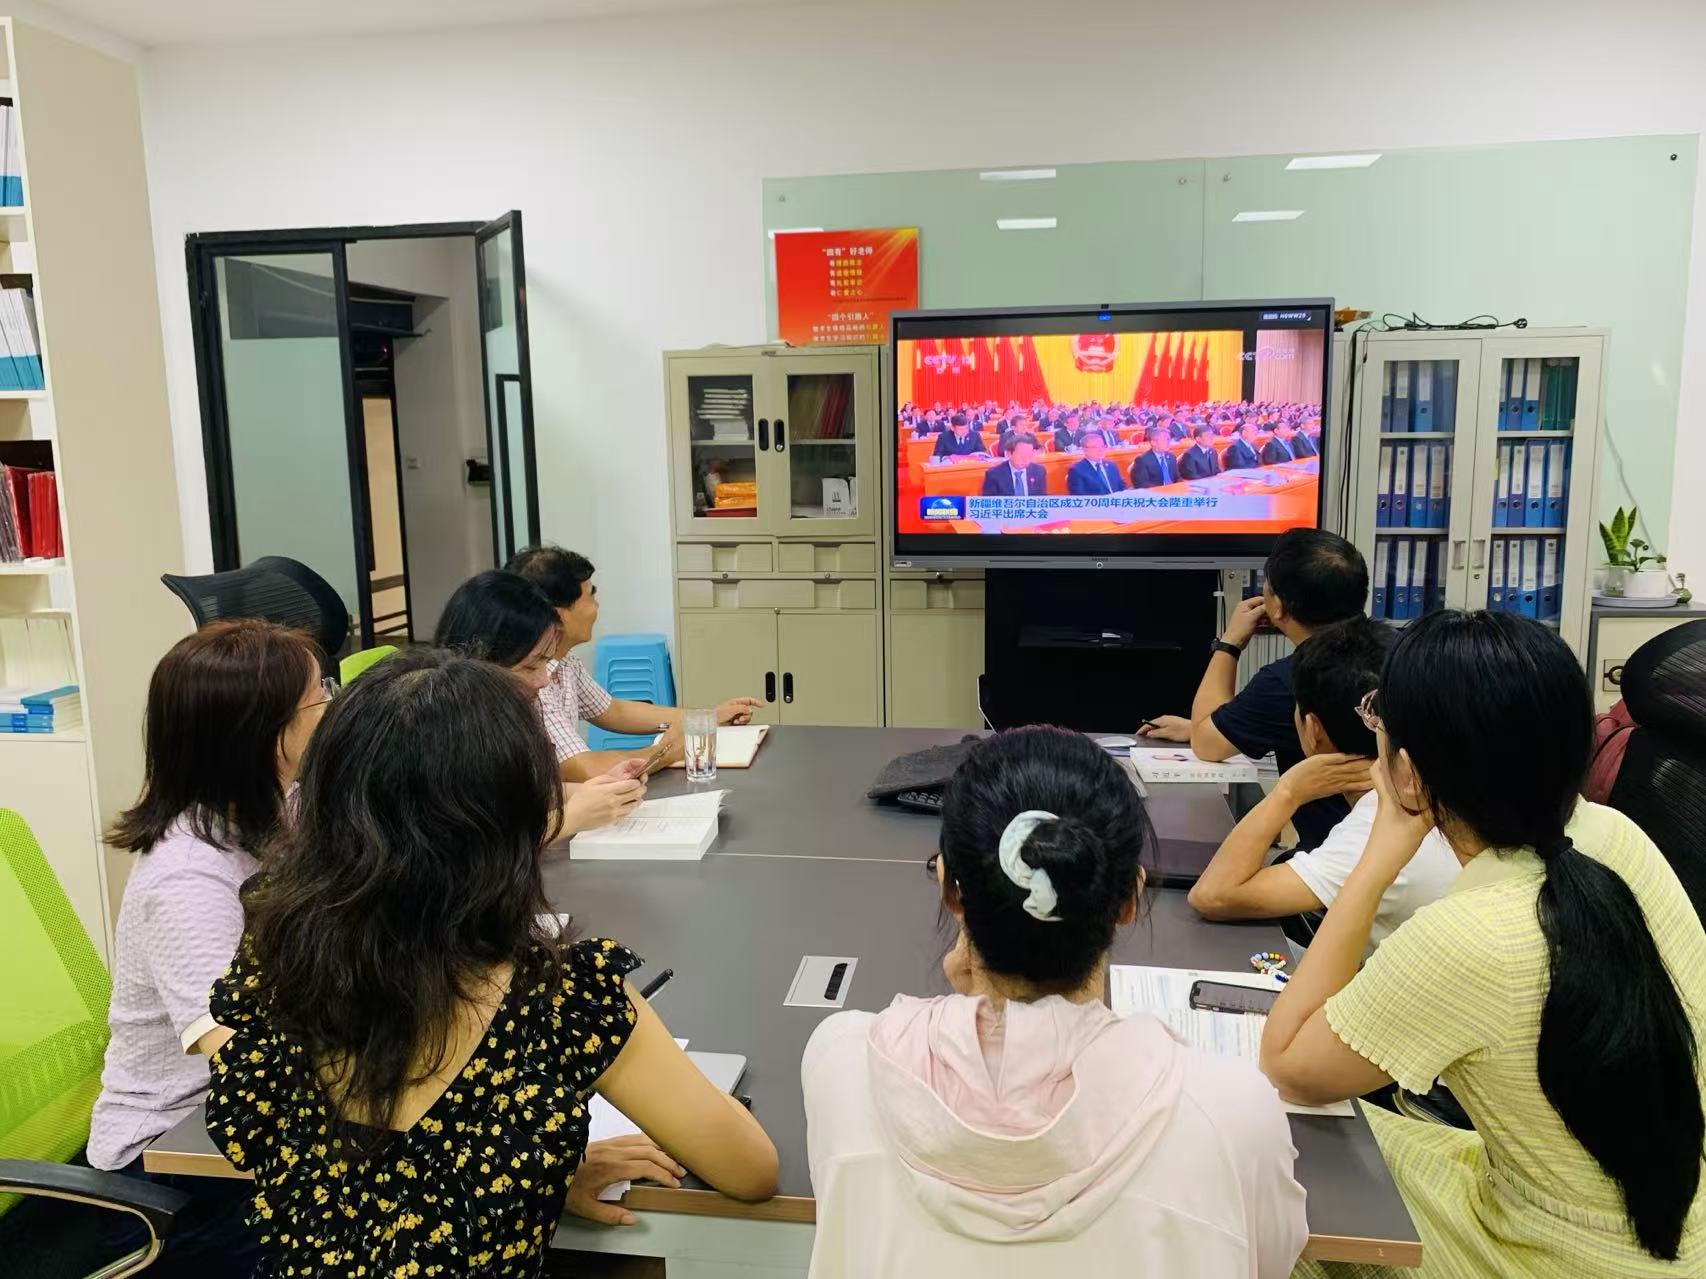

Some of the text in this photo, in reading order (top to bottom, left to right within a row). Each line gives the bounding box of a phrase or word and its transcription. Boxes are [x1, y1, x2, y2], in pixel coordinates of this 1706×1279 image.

[969, 497, 1218, 509] 新疆维吾尔自治区成立70周年庆祝大会隆重举行
[969, 508, 1048, 519] 习近平出席大会
